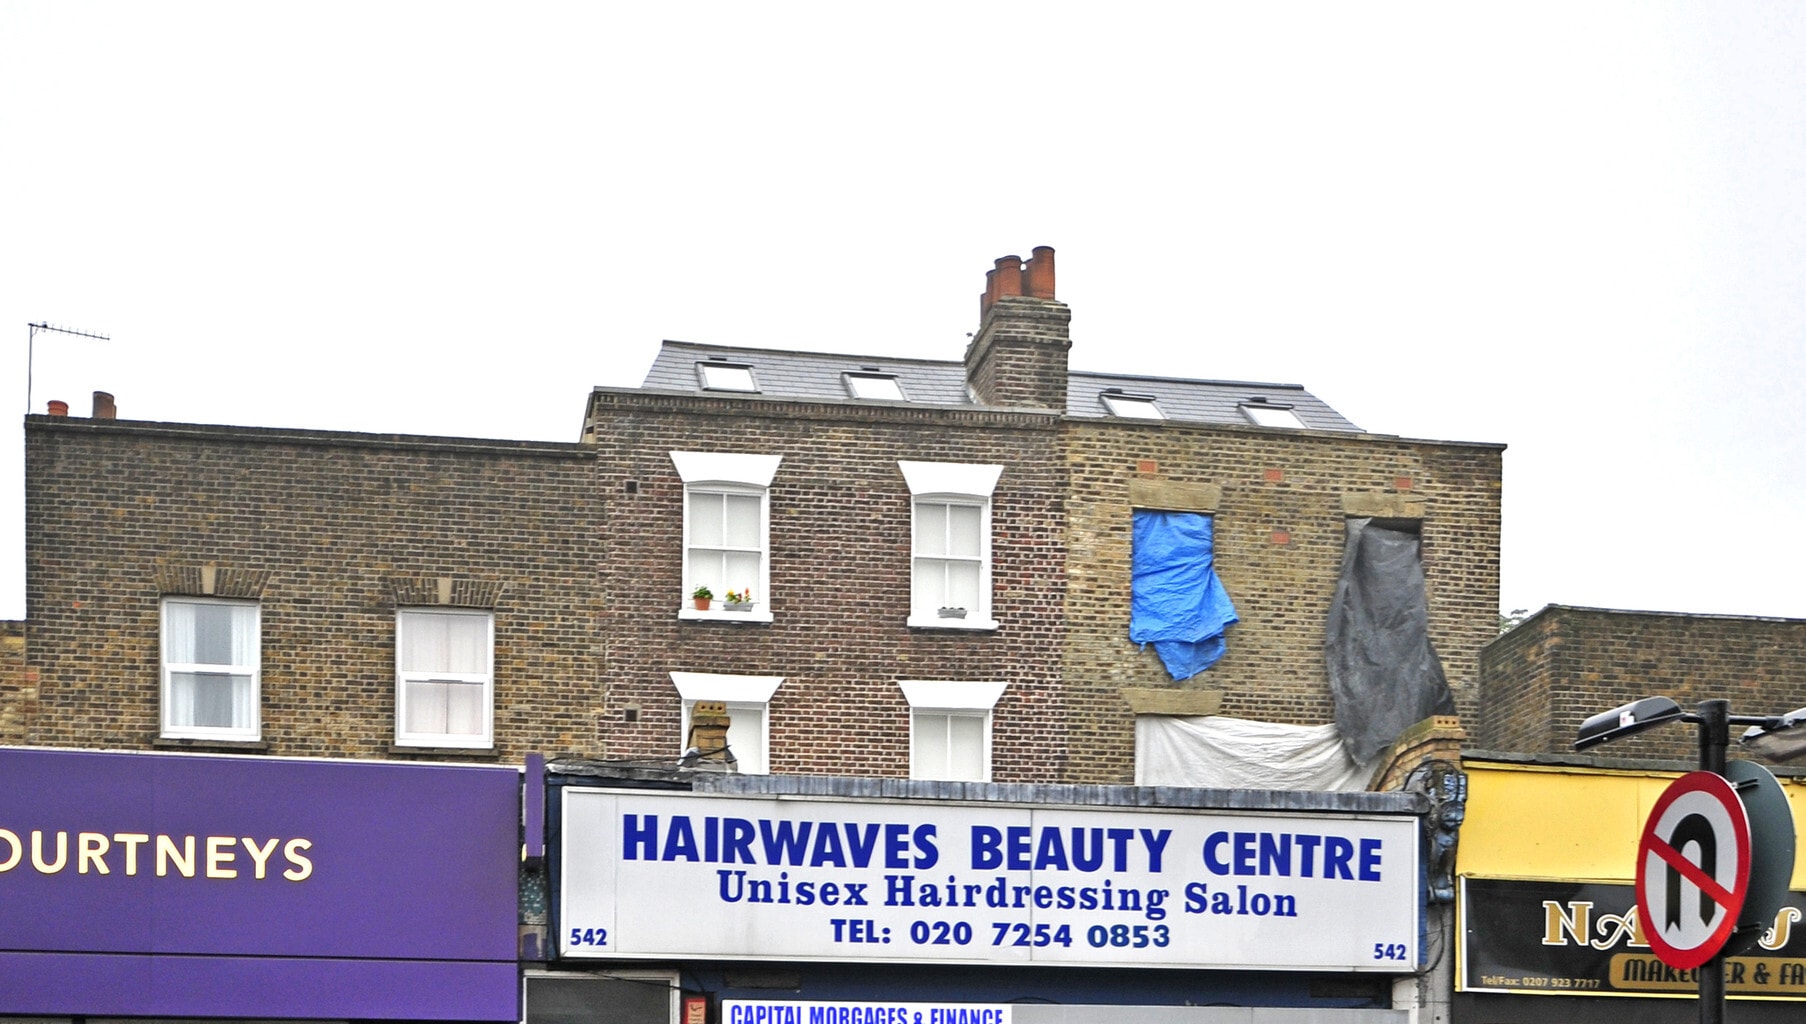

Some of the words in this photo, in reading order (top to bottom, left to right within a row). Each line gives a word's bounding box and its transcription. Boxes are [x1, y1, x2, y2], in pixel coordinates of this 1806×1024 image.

[0, 829, 313, 881] OURTNEYS
[622, 813, 940, 870] HAIRWAVES
[970, 826, 1173, 873] BEAUTY
[1202, 831, 1383, 882] CENTRE
[717, 870, 869, 906] Unisex
[884, 875, 1170, 921] Hairdressing
[1184, 882, 1297, 917] Salon
[570, 929, 607, 946] 542
[830, 918, 891, 944] TEL:
[909, 921, 973, 946] 020
[991, 922, 1073, 948] 7254
[1086, 924, 1170, 949] 0853
[1373, 943, 1406, 960] 542
[1522, 976, 1549, 987] 0207
[1551, 977, 1572, 988] 923
[1574, 978, 1600, 989] 7717
[1622, 958, 1745, 985] MAKEER
[1753, 962, 1771, 985] &
[1779, 963, 1806, 986] FA
